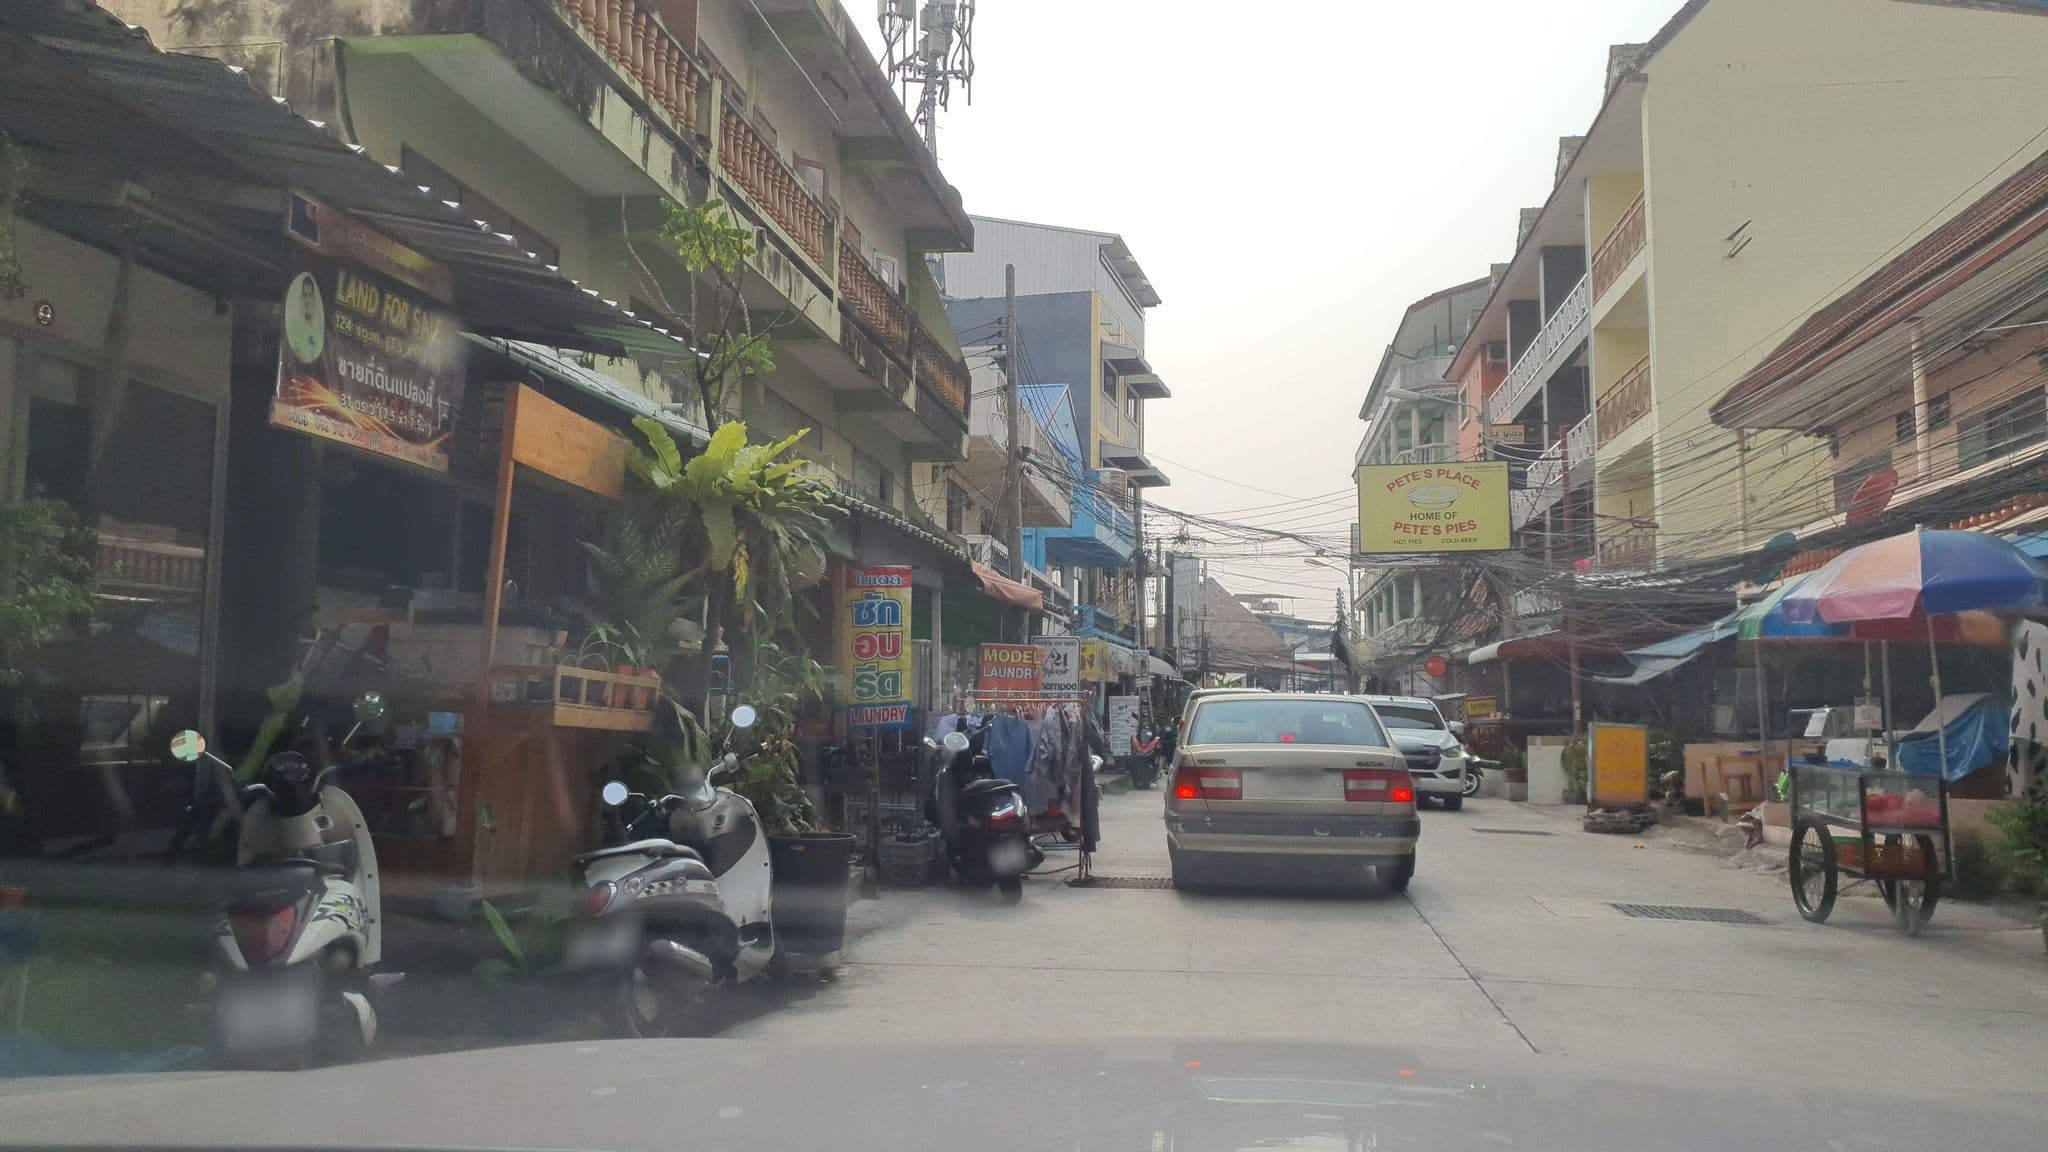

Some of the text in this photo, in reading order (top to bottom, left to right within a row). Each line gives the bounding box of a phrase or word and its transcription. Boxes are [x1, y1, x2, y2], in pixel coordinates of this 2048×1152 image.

[336, 270, 442, 342] LAND FOR SAL
[1386, 468, 1482, 493] PETE'S PLACE
[1393, 519, 1477, 535] PETE'S PIES
[1410, 511, 1458, 521] HOME OF
[851, 591, 903, 627] ซัก
[853, 632, 903, 660] อบ
[983, 648, 1042, 665] MODEL
[853, 662, 903, 699] รีด
[983, 666, 1039, 679] LAUNDRY
[849, 704, 907, 726] LAUNDRY
